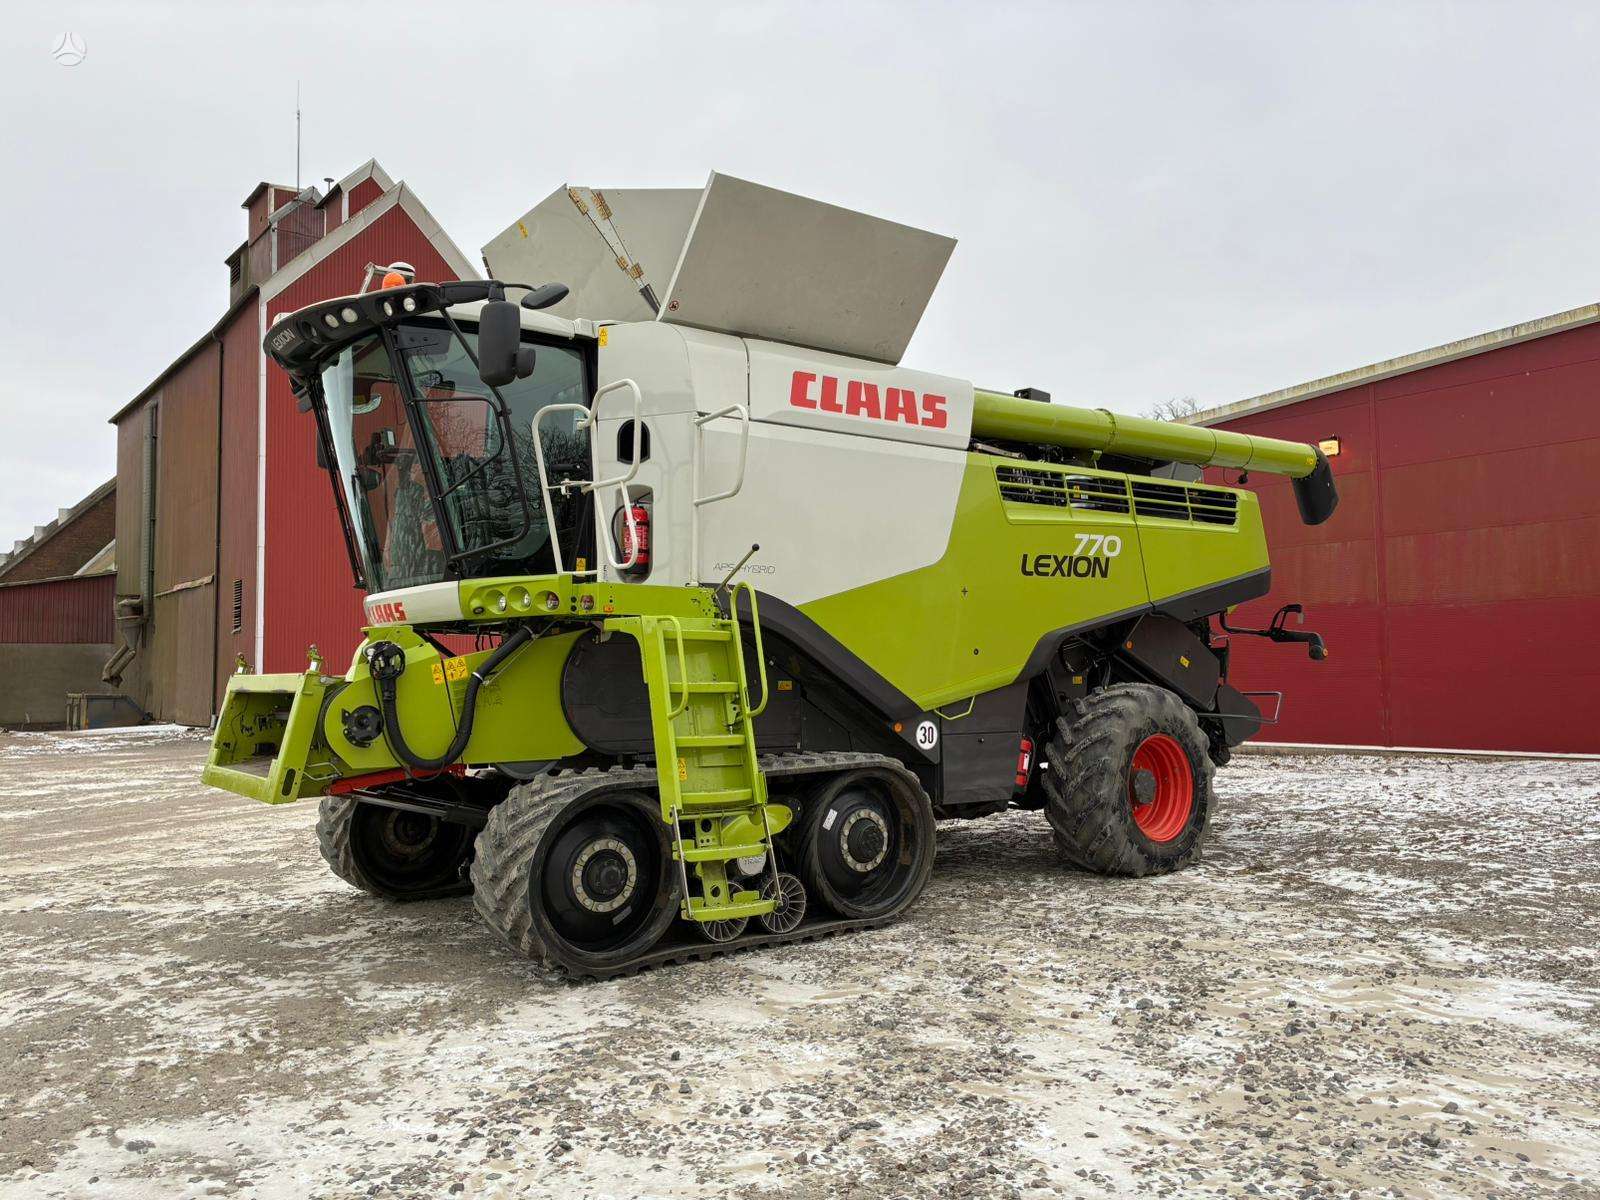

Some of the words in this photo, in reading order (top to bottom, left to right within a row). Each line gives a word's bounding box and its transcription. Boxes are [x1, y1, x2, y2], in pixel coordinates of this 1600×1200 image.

[790, 370, 948, 429] CLAAS
[1073, 533, 1122, 557] 770
[713, 562, 736, 572] APS
[1020, 553, 1110, 578] LEXION
[919, 726, 934, 744] 30
